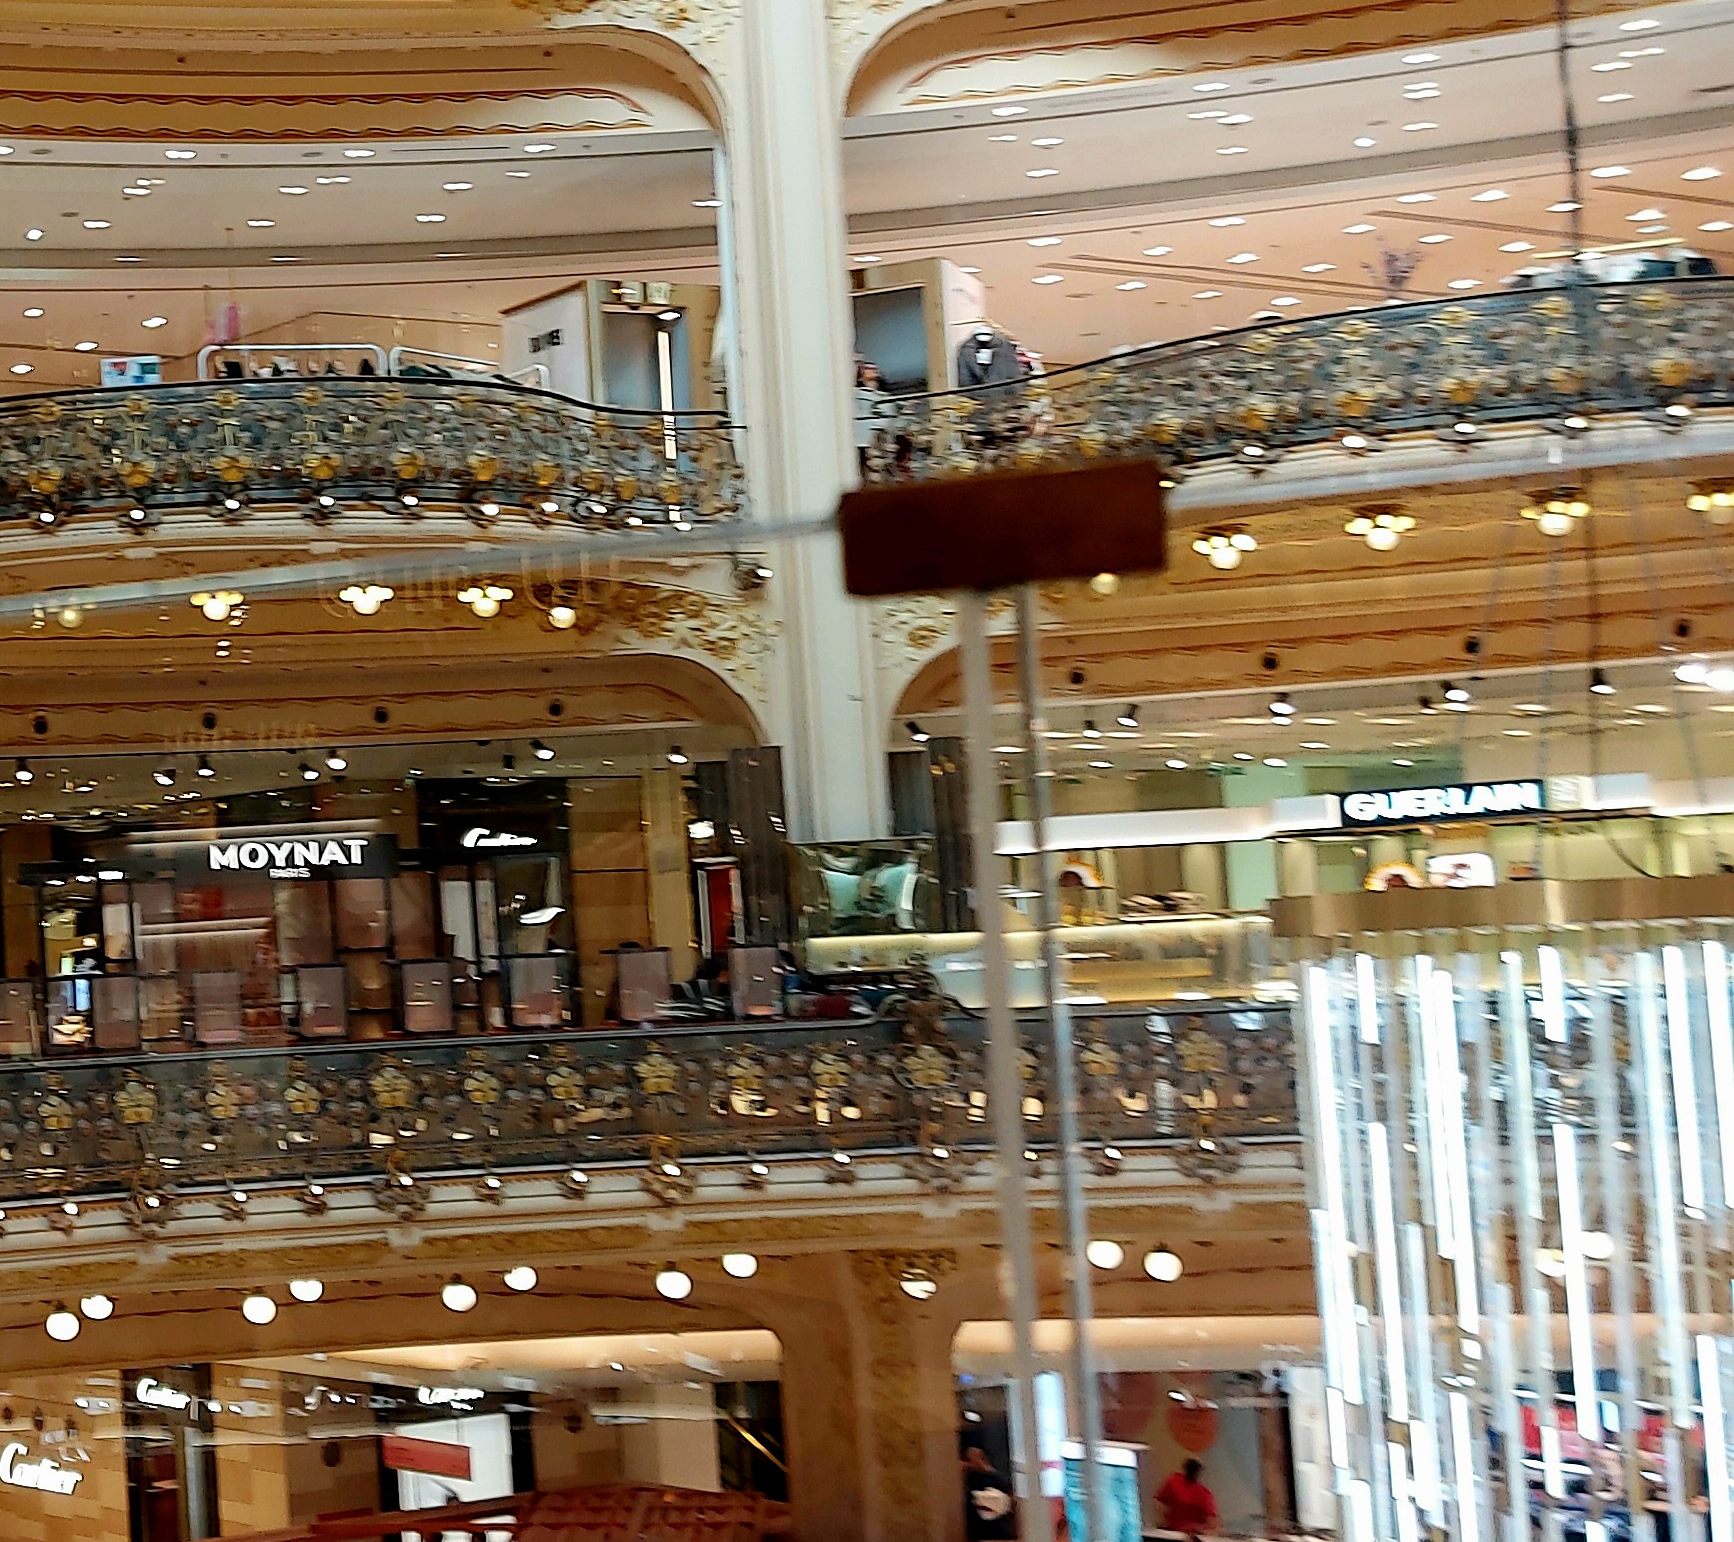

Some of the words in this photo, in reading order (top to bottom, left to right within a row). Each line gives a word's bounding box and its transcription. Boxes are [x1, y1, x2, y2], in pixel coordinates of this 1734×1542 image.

[1343, 781, 1542, 821] GUERLAIN
[209, 838, 368, 871] MOYNAT
[0, 1442, 83, 1495] Cartier
